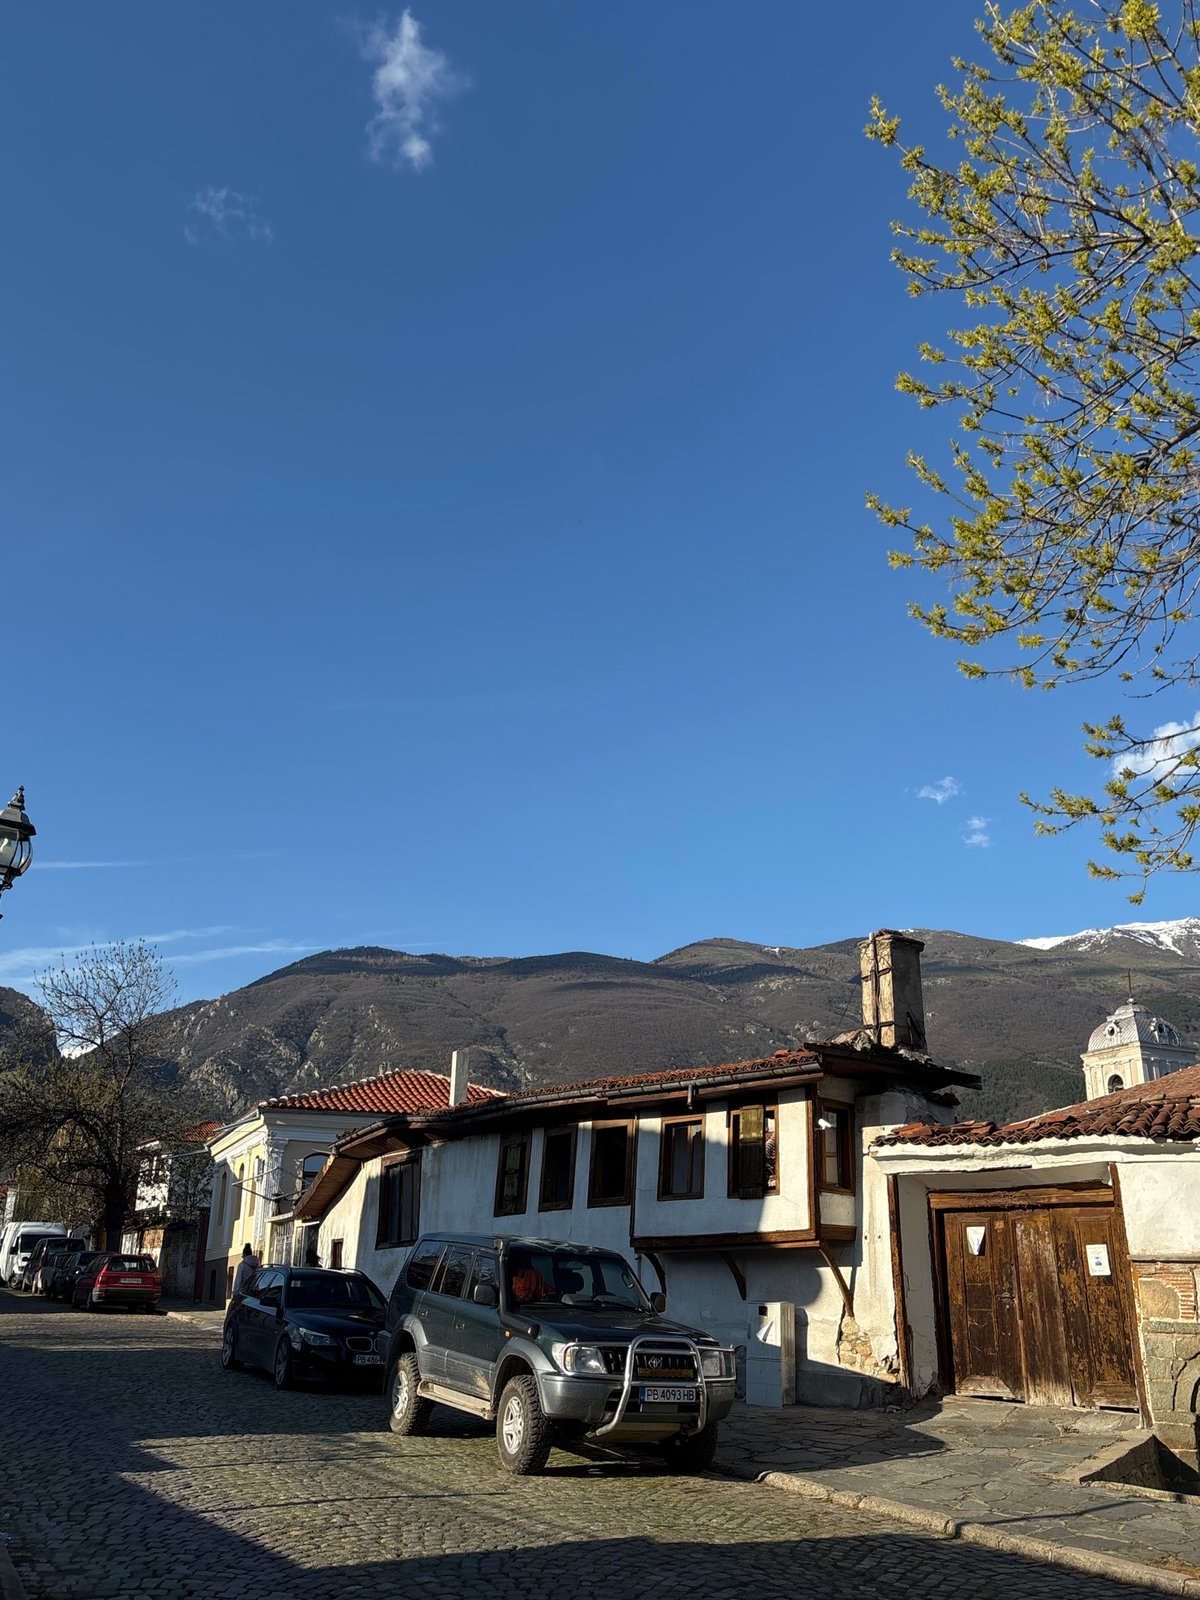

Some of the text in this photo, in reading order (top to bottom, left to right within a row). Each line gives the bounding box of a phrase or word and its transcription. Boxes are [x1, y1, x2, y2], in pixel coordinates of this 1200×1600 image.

[646, 1389, 695, 1401] PB 4093 HB
